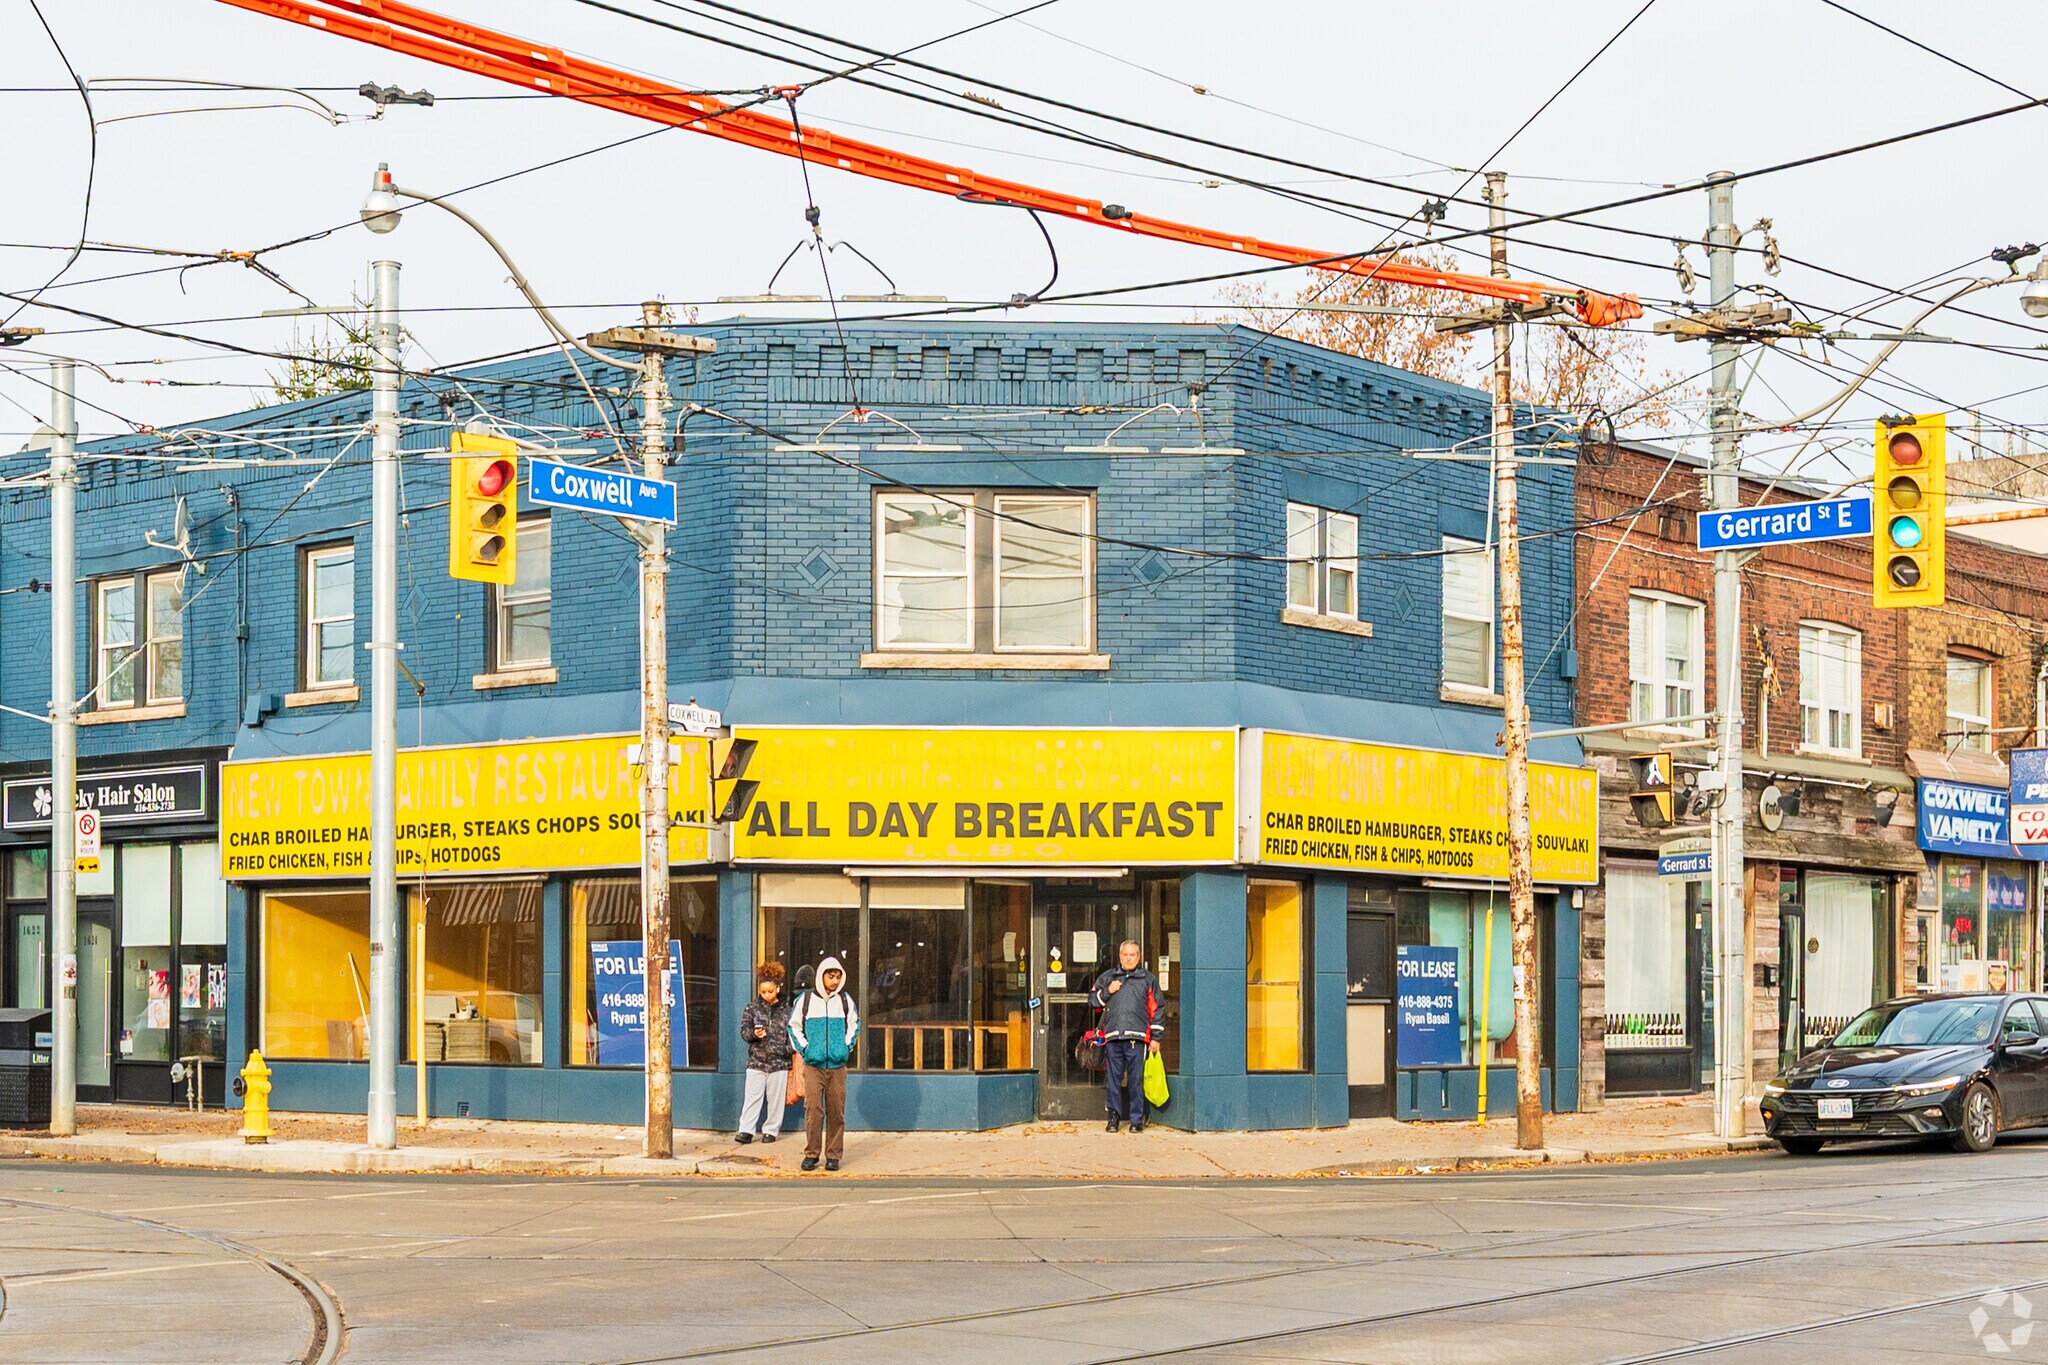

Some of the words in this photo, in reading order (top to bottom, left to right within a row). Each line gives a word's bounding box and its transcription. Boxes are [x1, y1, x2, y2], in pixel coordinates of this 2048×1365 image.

[550, 466, 633, 508] Coxwell
[638, 482, 658, 499] Ave
[1717, 506, 1811, 540] Gerrard
[1817, 505, 1831, 519] St
[1837, 503, 1852, 528] E
[670, 707, 706, 723] COXWELL
[709, 714, 718, 725] AV
[98, 785, 130, 806] Hair
[134, 783, 175, 804] Salon
[229, 773, 283, 820] NEW
[397, 756, 481, 811] AMILY
[1924, 785, 2006, 817] COXWELL
[746, 801, 830, 837] ALL
[848, 802, 938, 838] DAY
[955, 801, 1223, 838] BREAKFAST
[1929, 813, 2002, 844] VARIETY
[230, 830, 270, 847] CHAR
[275, 827, 342, 845] BROILED
[347, 822, 456, 842] HAURGER,
[463, 818, 531, 837] STEAKS
[536, 816, 600, 834] CHOPS
[1266, 811, 1303, 831] CHAR
[1308, 815, 1361, 835] BROILED
[1365, 820, 1445, 844] HAMBURGER,
[1449, 827, 1492, 846] STEAKS
[1537, 834, 1589, 853] SOUVLAKI
[229, 855, 265, 870] FRIED
[269, 852, 329, 870] CHICKEN,
[333, 851, 363, 867] FISH
[431, 845, 501, 863] HOTDOGS
[1266, 838, 1298, 855] FRIED
[1302, 840, 1351, 863] CHICKEN,
[1355, 845, 1377, 861] FISH
[1381, 846, 1388, 862] &
[1391, 847, 1424, 868] CHIPS,
[1427, 850, 1474, 868] HOTDOGS
[1664, 857, 1697, 872] Gerrard
[23, 925, 40, 935] 1622
[1955, 917, 1972, 933] ATM
[595, 957, 625, 975] FOR
[1397, 960, 1418, 977] FOR
[1421, 961, 1455, 978] LEASE
[1399, 995, 1453, 1008] 416-888-4375
[611, 1011, 637, 1026] Ryan
[1405, 1012, 1425, 1026] Ryan
[1427, 1012, 1450, 1024] Bassil
[33, 1053, 49, 1063] Litter
